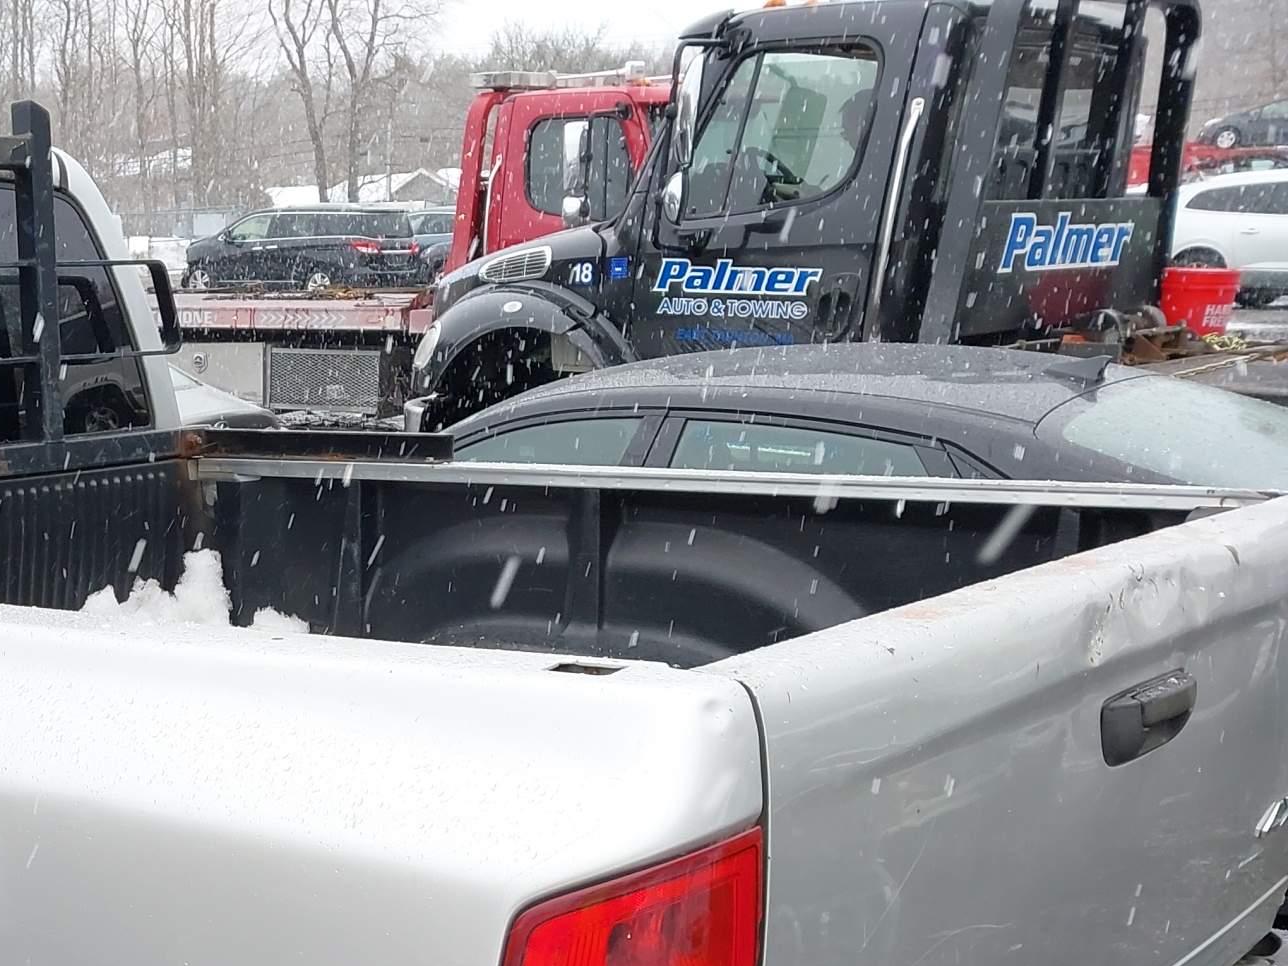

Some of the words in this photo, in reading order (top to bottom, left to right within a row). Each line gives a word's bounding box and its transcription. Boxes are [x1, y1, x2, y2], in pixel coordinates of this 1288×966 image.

[996, 211, 1135, 274] Palmer
[652, 257, 824, 296] Palmer
[656, 297, 709, 315] AUTO
[710, 299, 726, 316] &
[726, 299, 809, 319] TOWING
